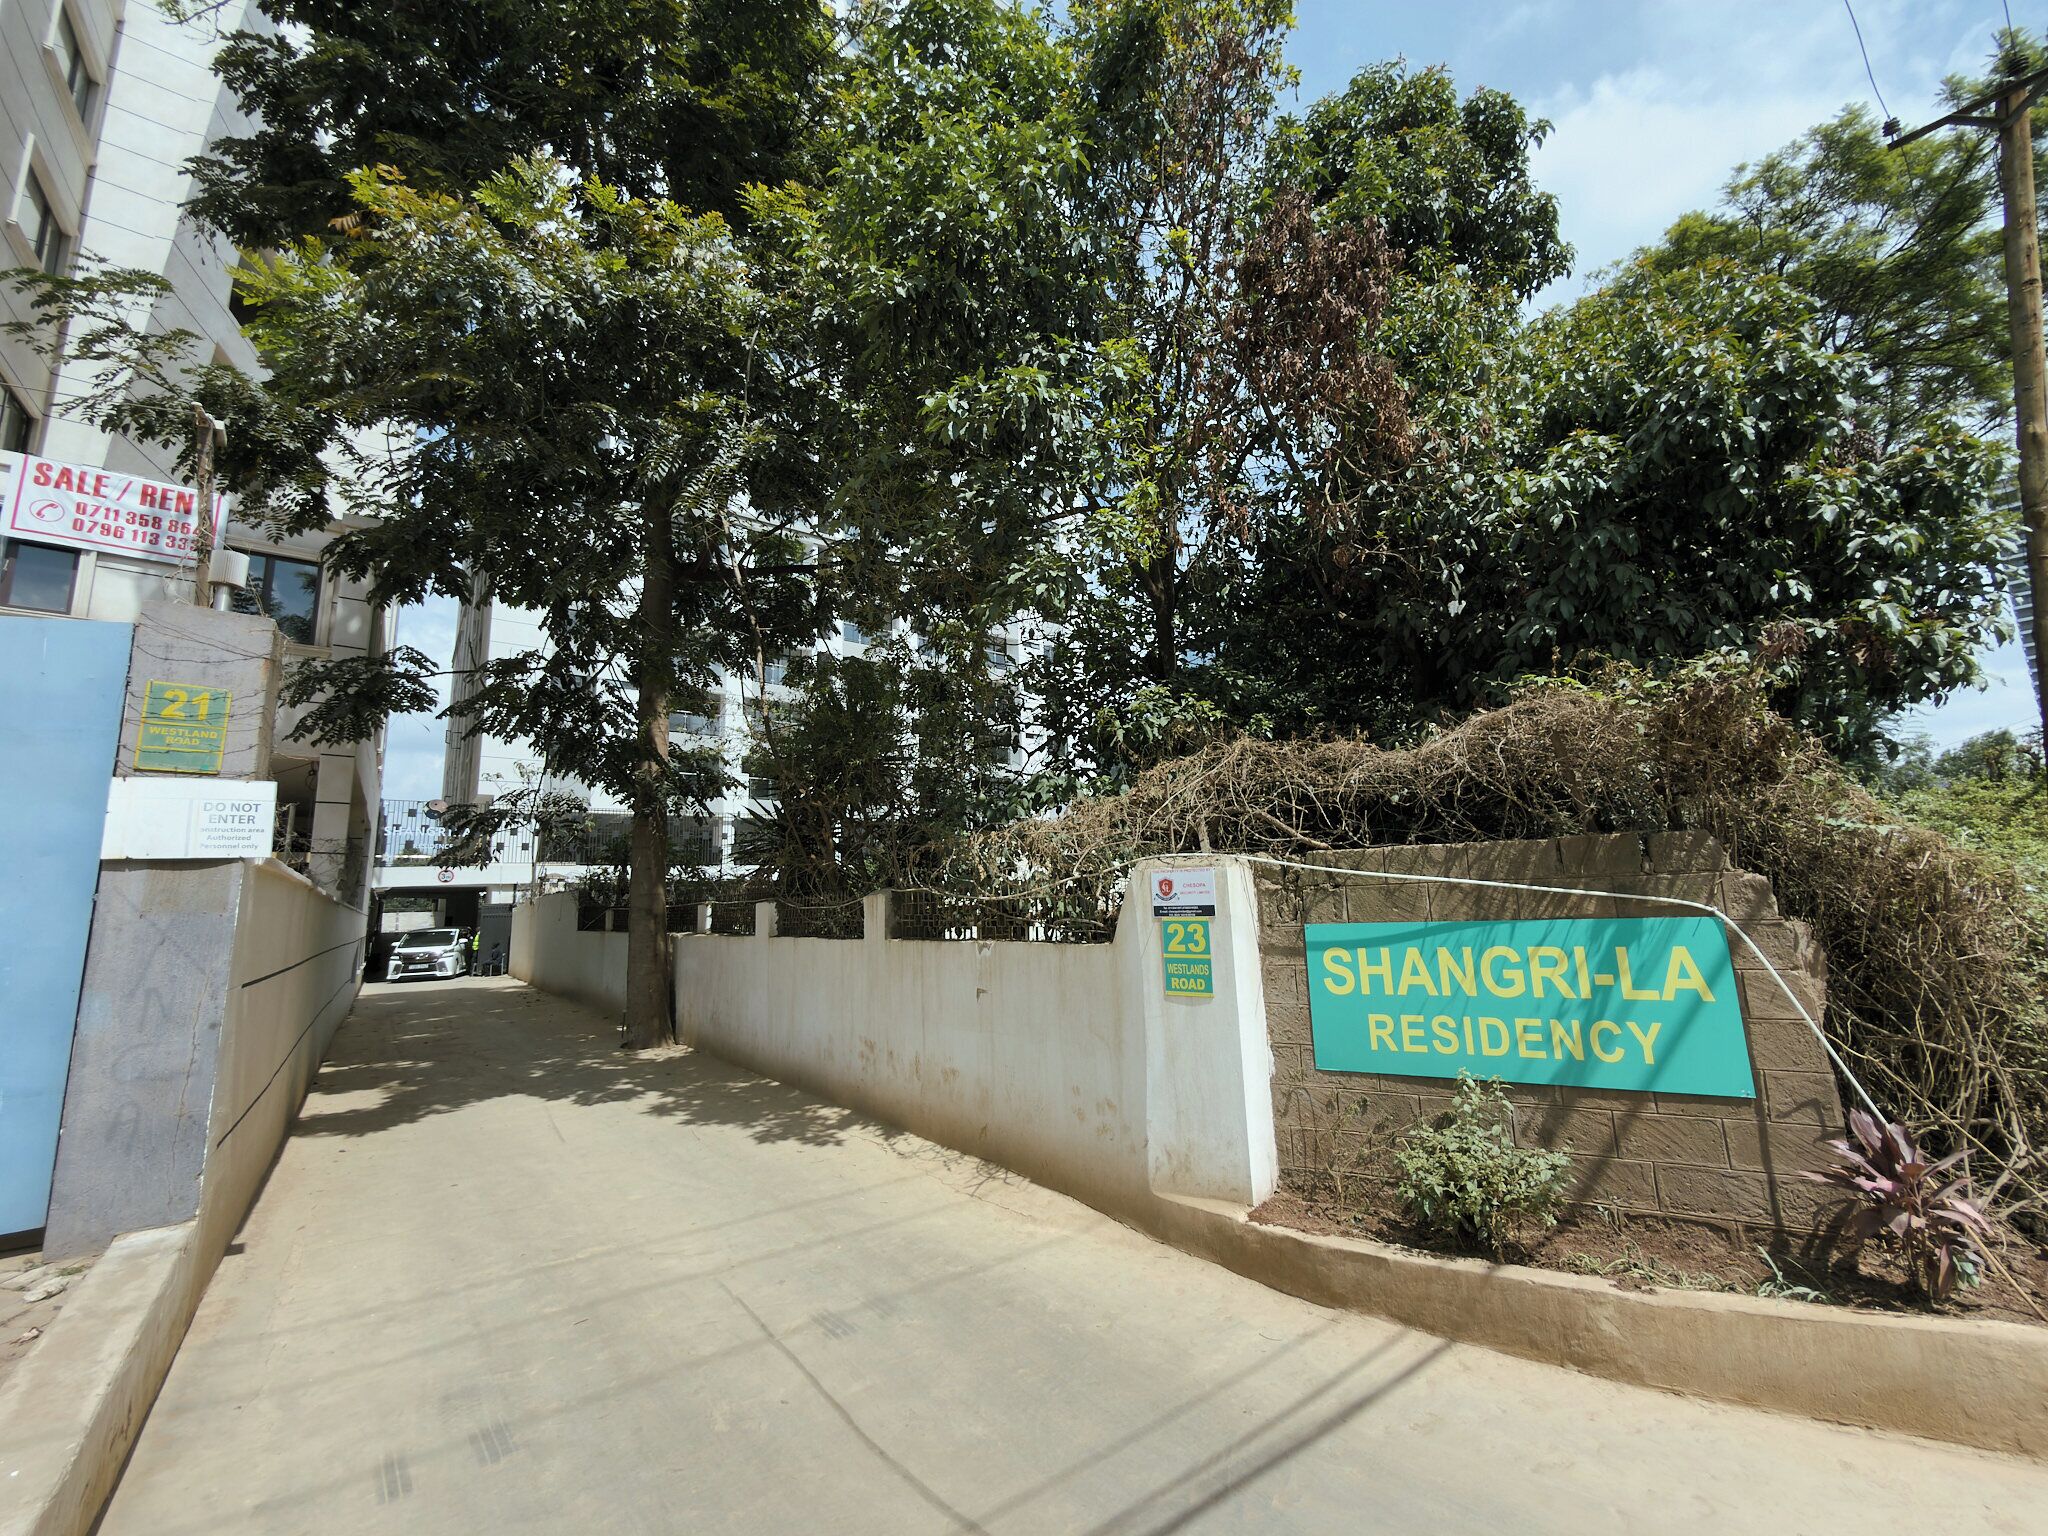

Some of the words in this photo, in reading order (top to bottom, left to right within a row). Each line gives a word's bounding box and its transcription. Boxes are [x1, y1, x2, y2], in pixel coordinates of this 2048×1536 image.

[33, 462, 112, 499] SALE
[139, 484, 195, 516] REN
[75, 501, 120, 522] 0711
[125, 511, 163, 530] 358
[72, 518, 125, 539] 0796
[131, 529, 160, 546] 113
[160, 688, 213, 721] 21
[150, 726, 218, 739] WESTLAND
[165, 736, 200, 746] ROAD
[203, 802, 226, 812] DO
[230, 803, 262, 813] NOT
[208, 814, 256, 824] ENTER
[1167, 923, 1207, 953] 23
[1167, 963, 1209, 976] WESTLANDS
[1322, 945, 1716, 1003] SHANGRI-LA
[1171, 977, 1206, 991] ROAD
[1367, 1013, 1662, 1065] RESIDENCY
